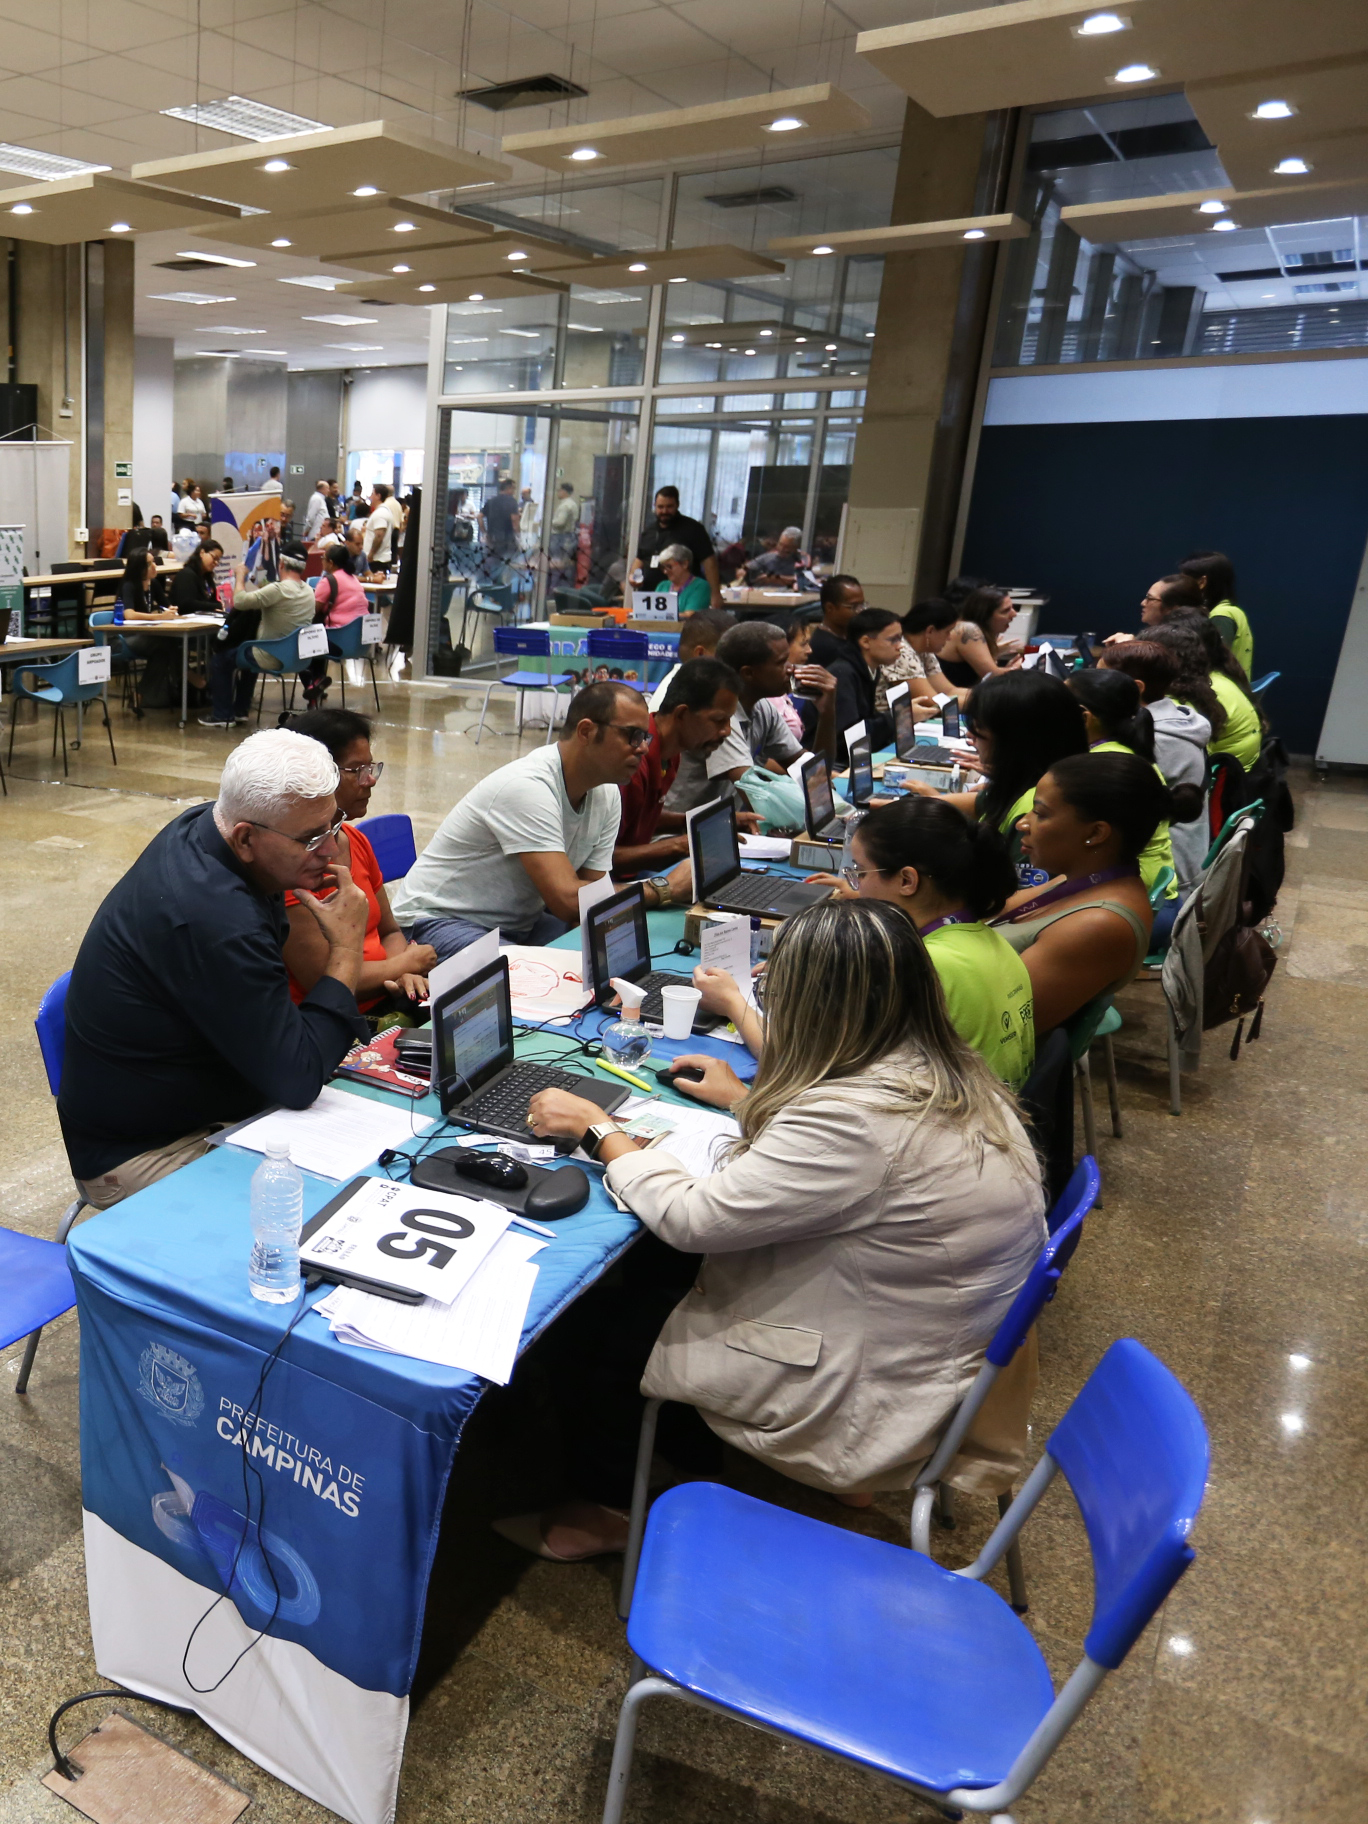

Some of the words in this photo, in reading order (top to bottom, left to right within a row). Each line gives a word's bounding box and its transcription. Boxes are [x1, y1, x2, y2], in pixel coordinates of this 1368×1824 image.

[642, 596, 667, 611] 18
[376, 1208, 476, 1270] 05
[216, 1416, 361, 1517] CAMPINAS
[219, 1396, 333, 1475] PREFEITURA
[338, 1464, 366, 1494] DE
